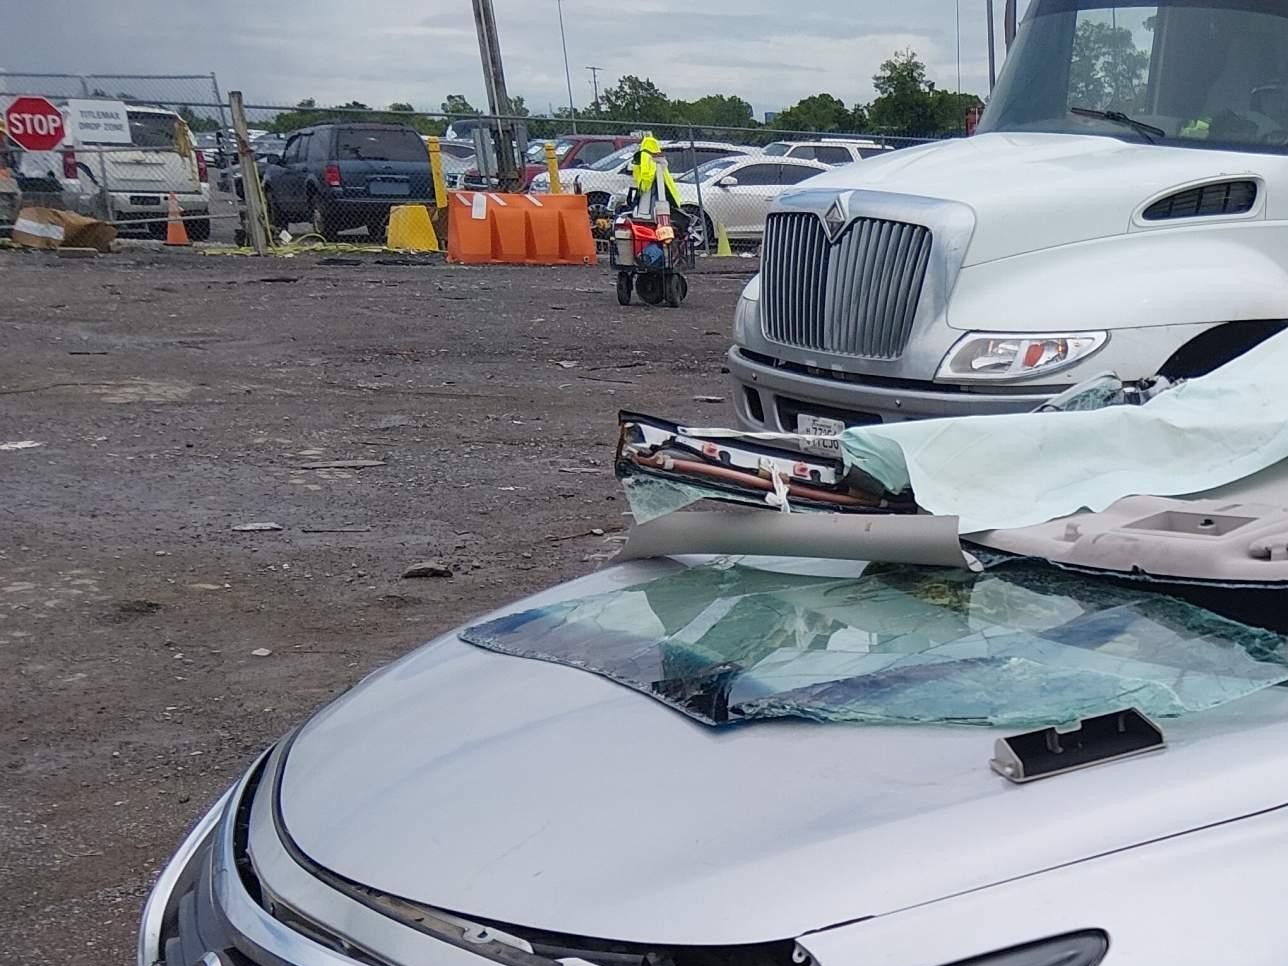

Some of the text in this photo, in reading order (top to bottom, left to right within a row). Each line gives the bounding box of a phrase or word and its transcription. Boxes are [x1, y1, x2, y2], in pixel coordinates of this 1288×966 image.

[9, 112, 61, 135] STOP
[79, 122, 124, 131] DROP ZONE
